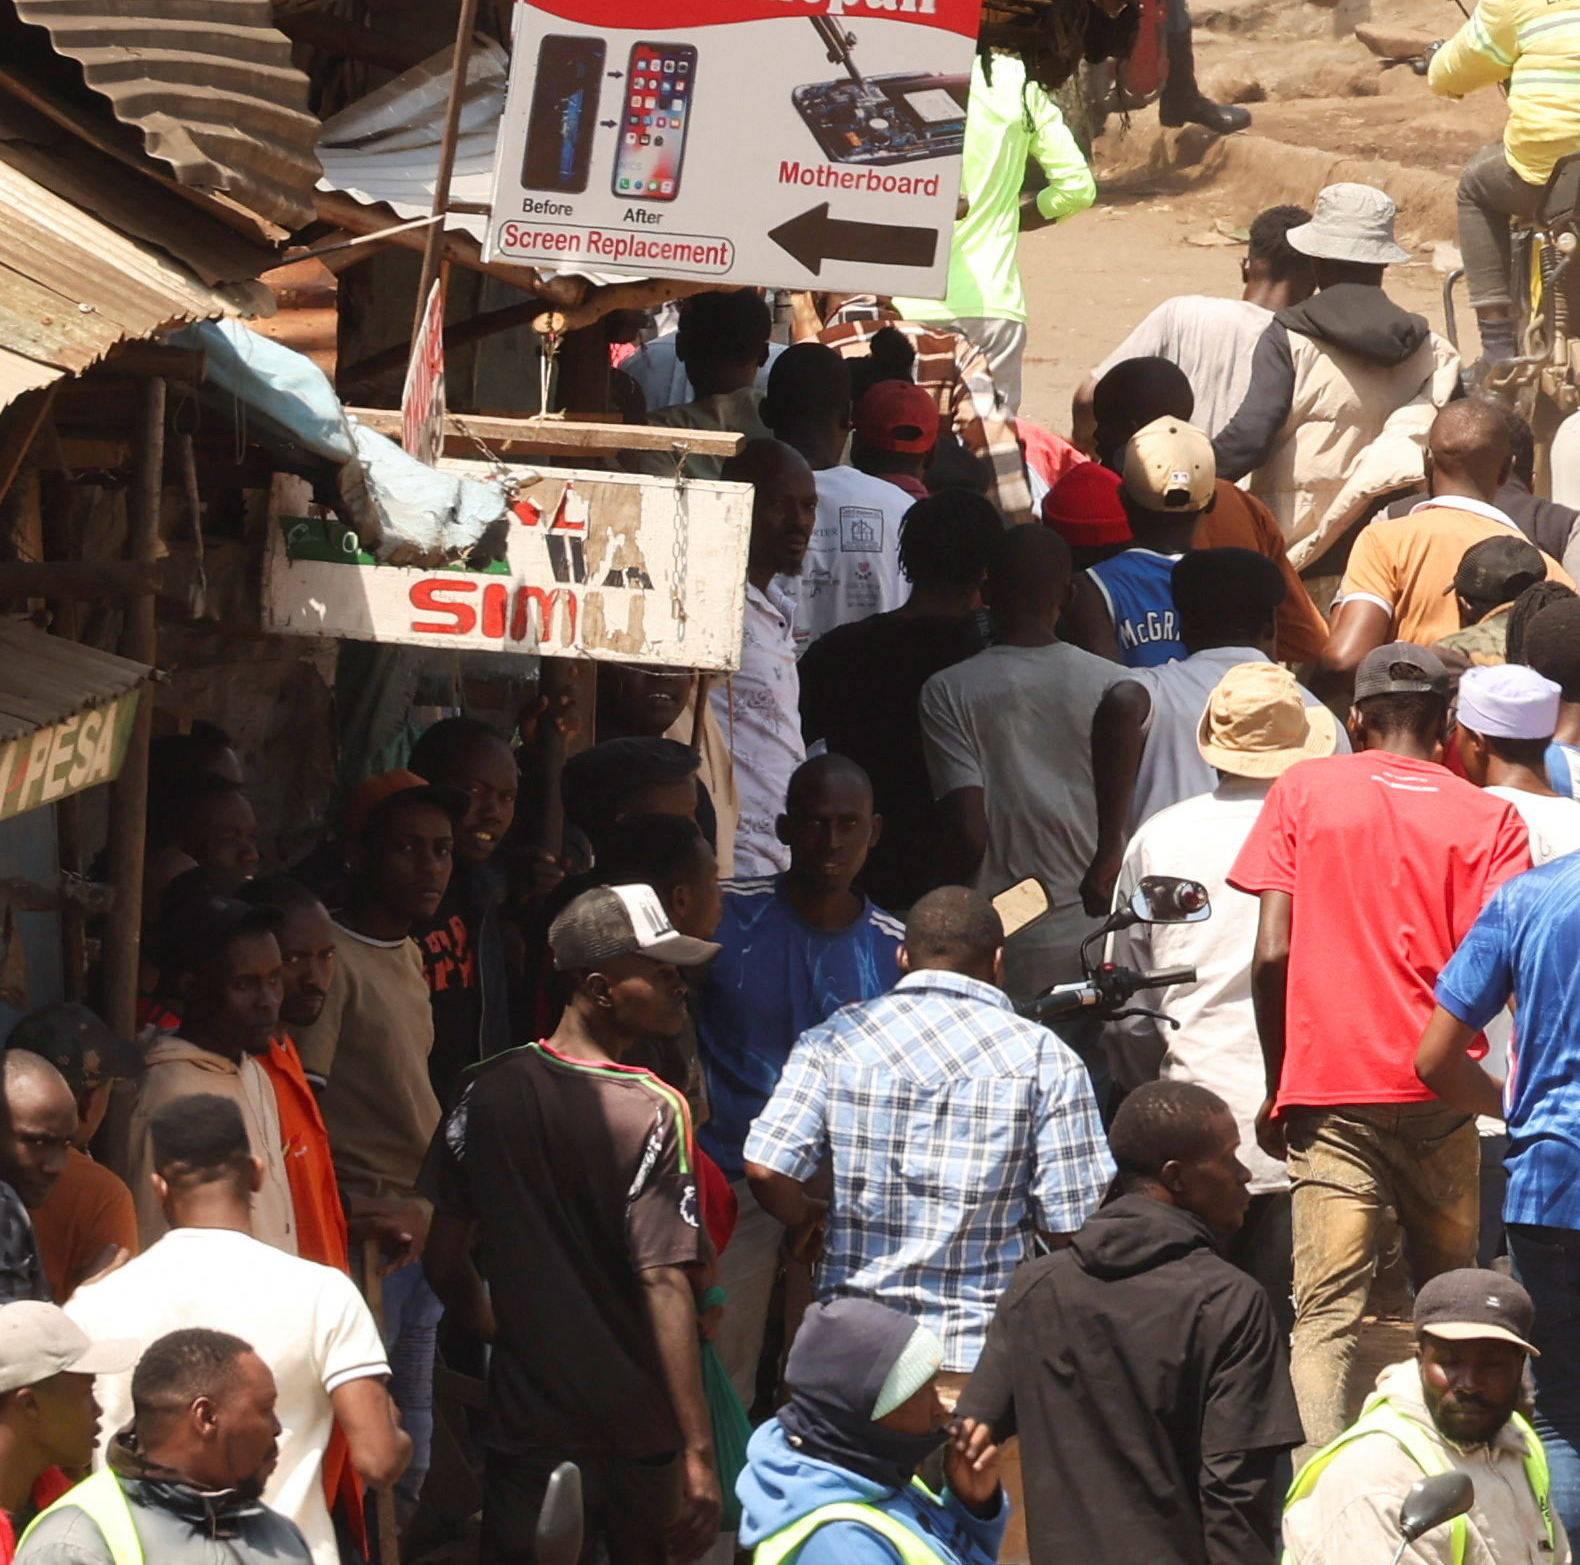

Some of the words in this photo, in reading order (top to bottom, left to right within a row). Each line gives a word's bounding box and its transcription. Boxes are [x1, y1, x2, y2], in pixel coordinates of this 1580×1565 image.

[778, 160, 939, 197] Motherboard
[522, 197, 574, 217] Before
[623, 207, 664, 225] After
[504, 222, 581, 254] Screen
[586, 231, 728, 267] Replacement
[1120, 610, 1181, 650] McGR
